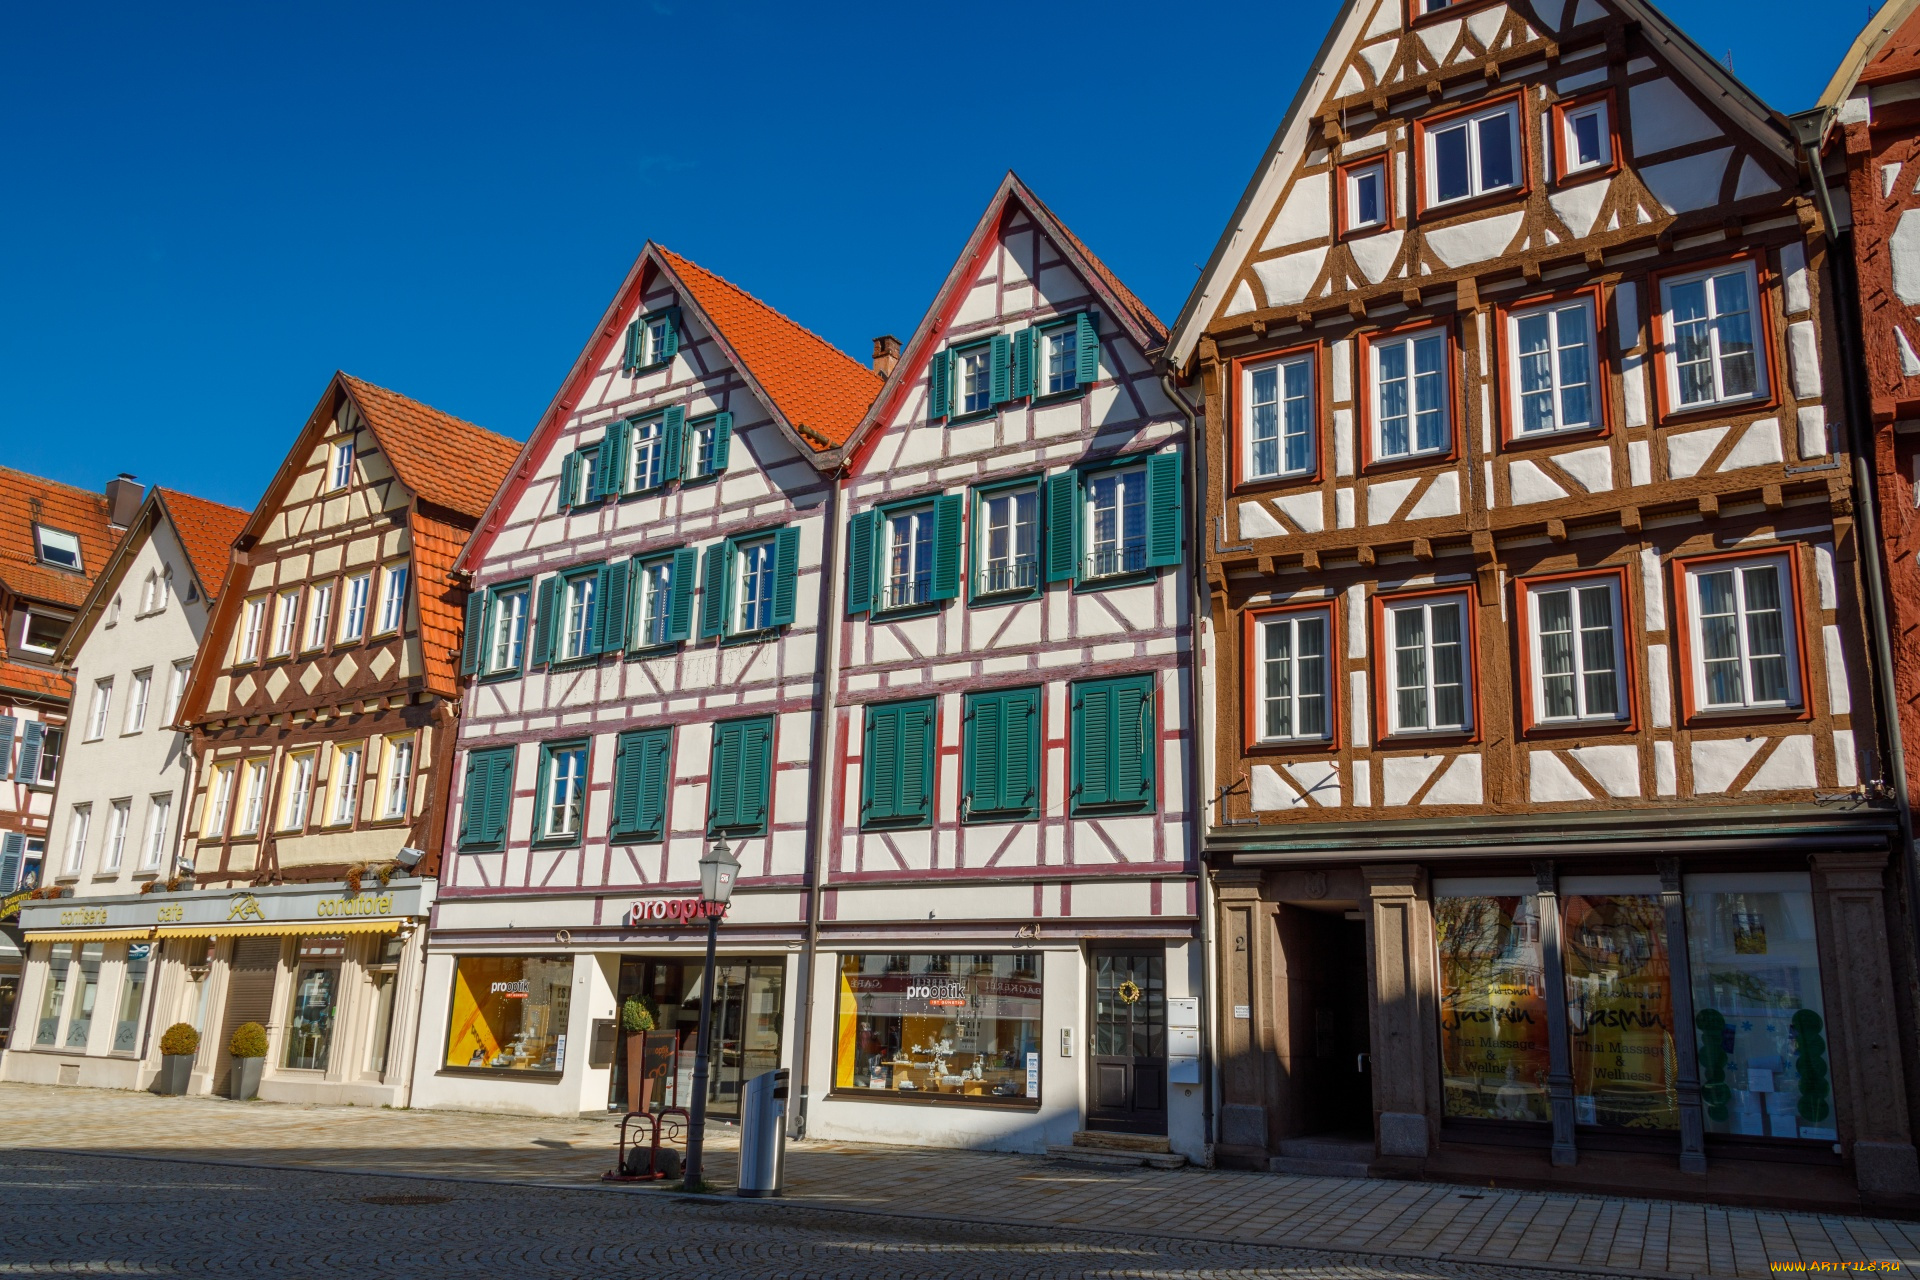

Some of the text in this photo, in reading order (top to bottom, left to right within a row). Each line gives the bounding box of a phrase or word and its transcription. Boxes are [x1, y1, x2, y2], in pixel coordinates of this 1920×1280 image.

[317, 891, 394, 917] conditorei
[60, 905, 108, 926] confiserie
[1235, 936, 1246, 952] 2
[491, 978, 531, 994] prooptik
[906, 983, 966, 1000] prooptik
[1568, 994, 1667, 1037] Jasmin
[1480, 1036, 1536, 1052] Massage
[1575, 1040, 1605, 1053] Thai
[1486, 1049, 1496, 1061] &
[1615, 1055, 1626, 1067] &
[1593, 1067, 1652, 1081] Wellness
